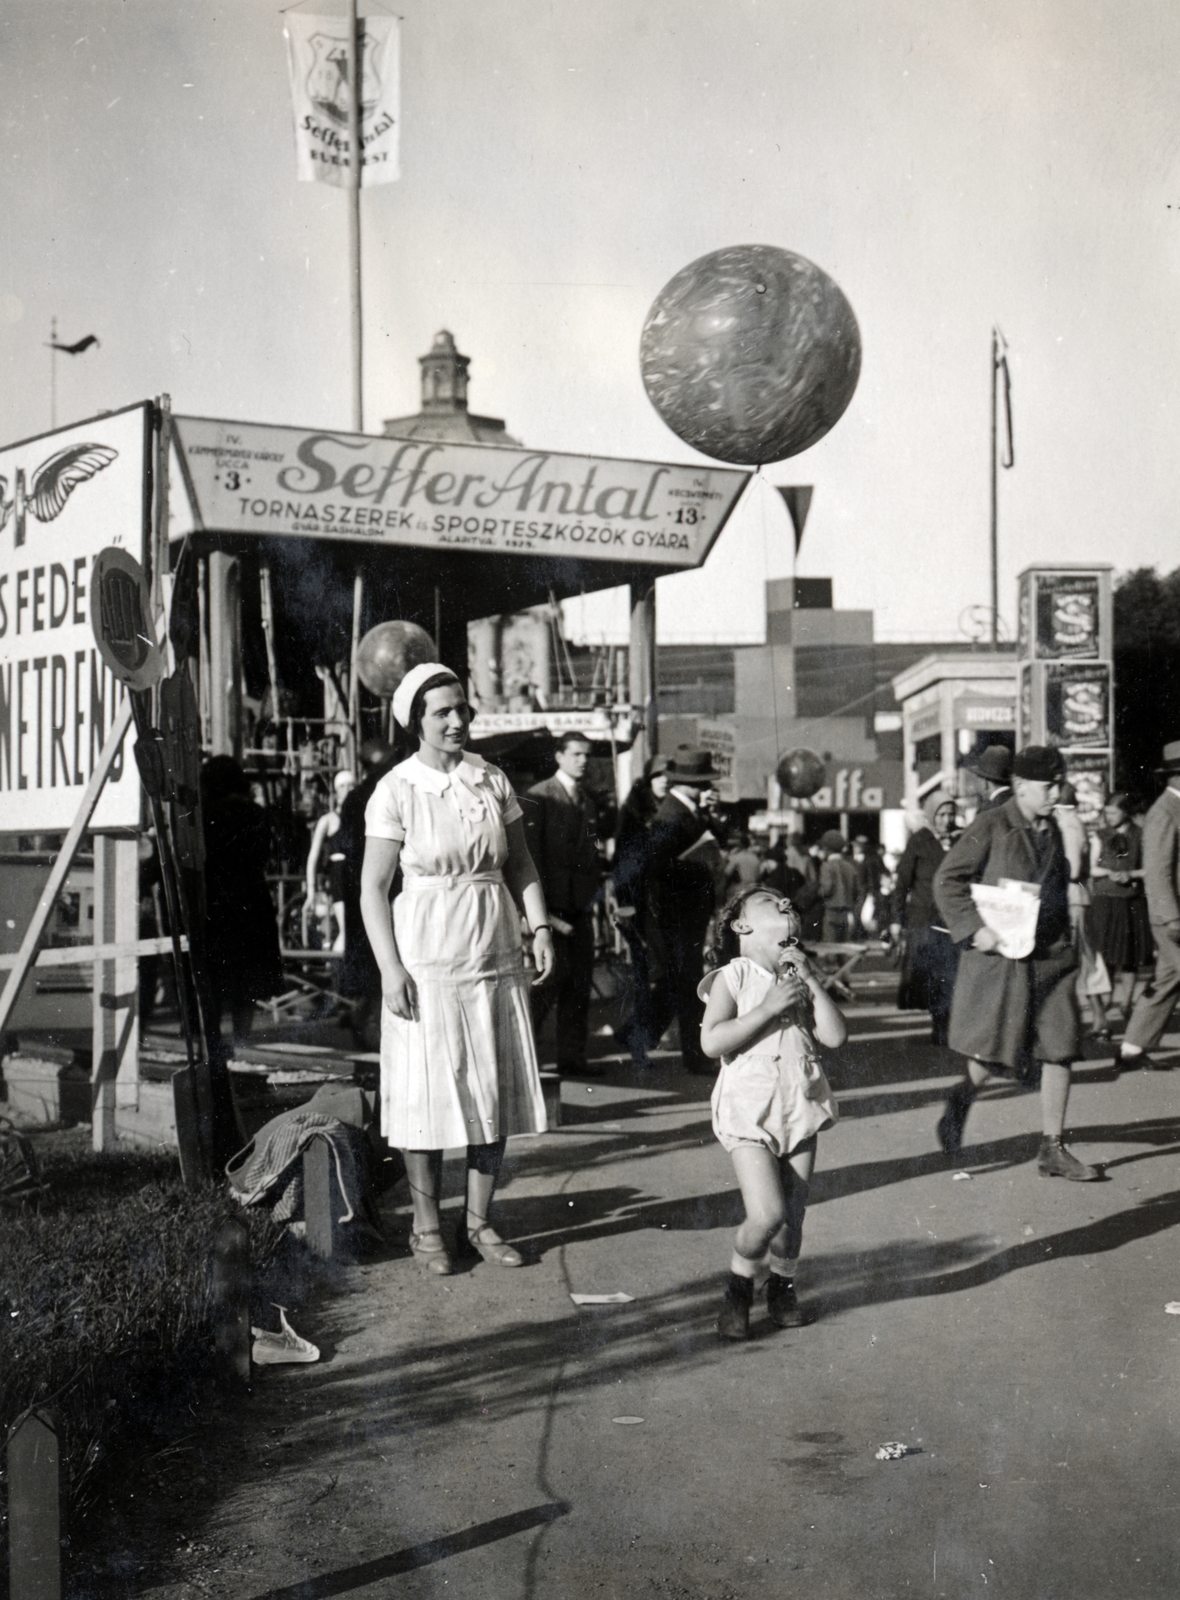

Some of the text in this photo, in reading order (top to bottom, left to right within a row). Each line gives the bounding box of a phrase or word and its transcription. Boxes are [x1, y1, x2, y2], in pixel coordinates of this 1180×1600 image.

[277, 433, 671, 521] Seffer Antal
[240, 497, 415, 529] TORNASZEREK
[632, 526, 691, 551] GYÁRA
[675, 507, 699, 525] 13
[552, 717, 594, 728] BANK
[788, 768, 884, 810] affa
